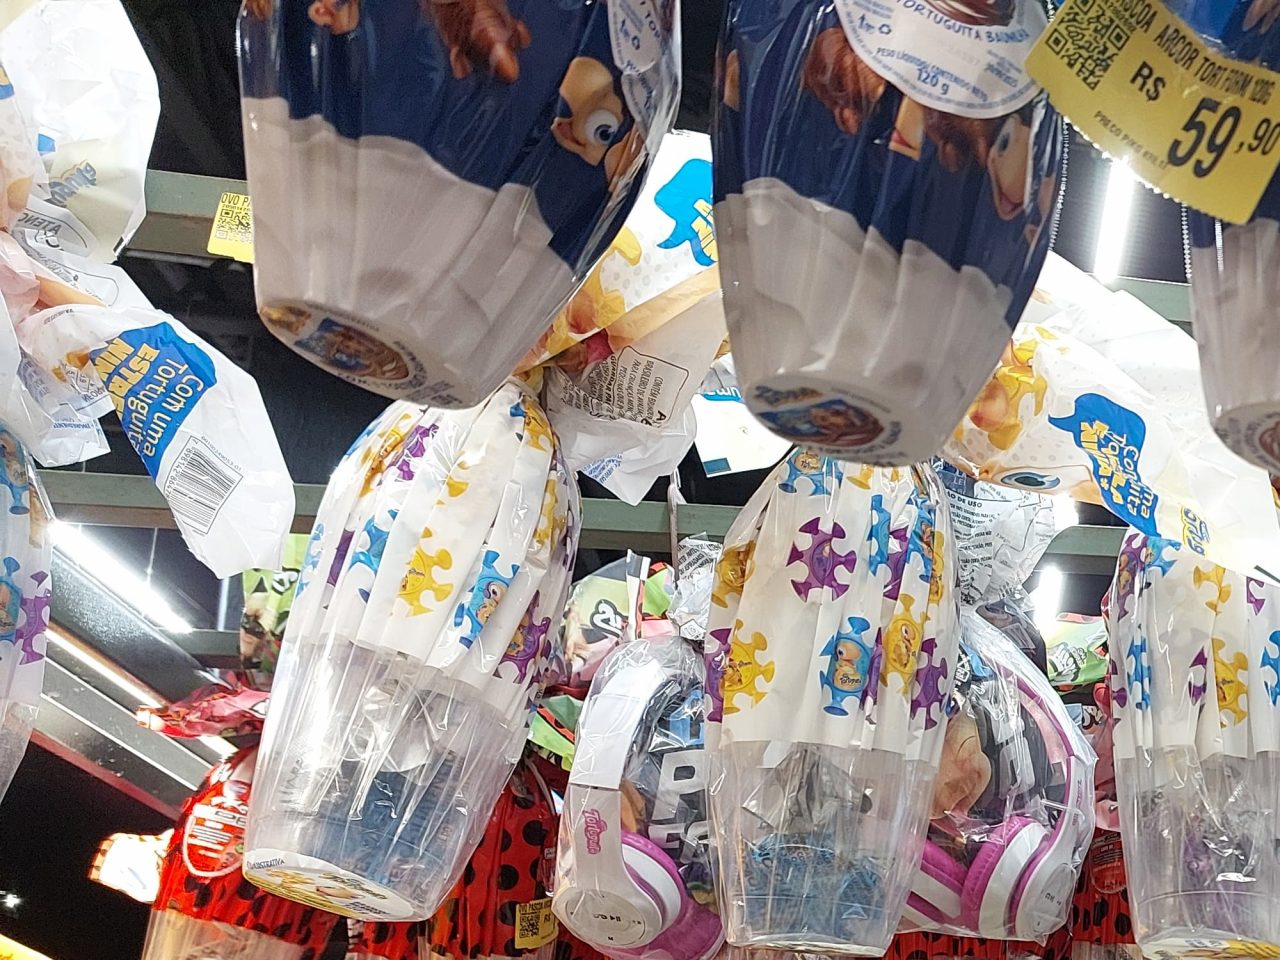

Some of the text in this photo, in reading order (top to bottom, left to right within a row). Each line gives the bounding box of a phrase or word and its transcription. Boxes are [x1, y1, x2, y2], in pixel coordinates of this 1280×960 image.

[1154, 24, 1200, 69] ARCOR
[1197, 54, 1226, 87] TORT
[916, 68, 950, 95] 120 g
[1130, 61, 1166, 103] R$
[221, 193, 240, 206] OVO
[144, 374, 203, 457] Com uma
